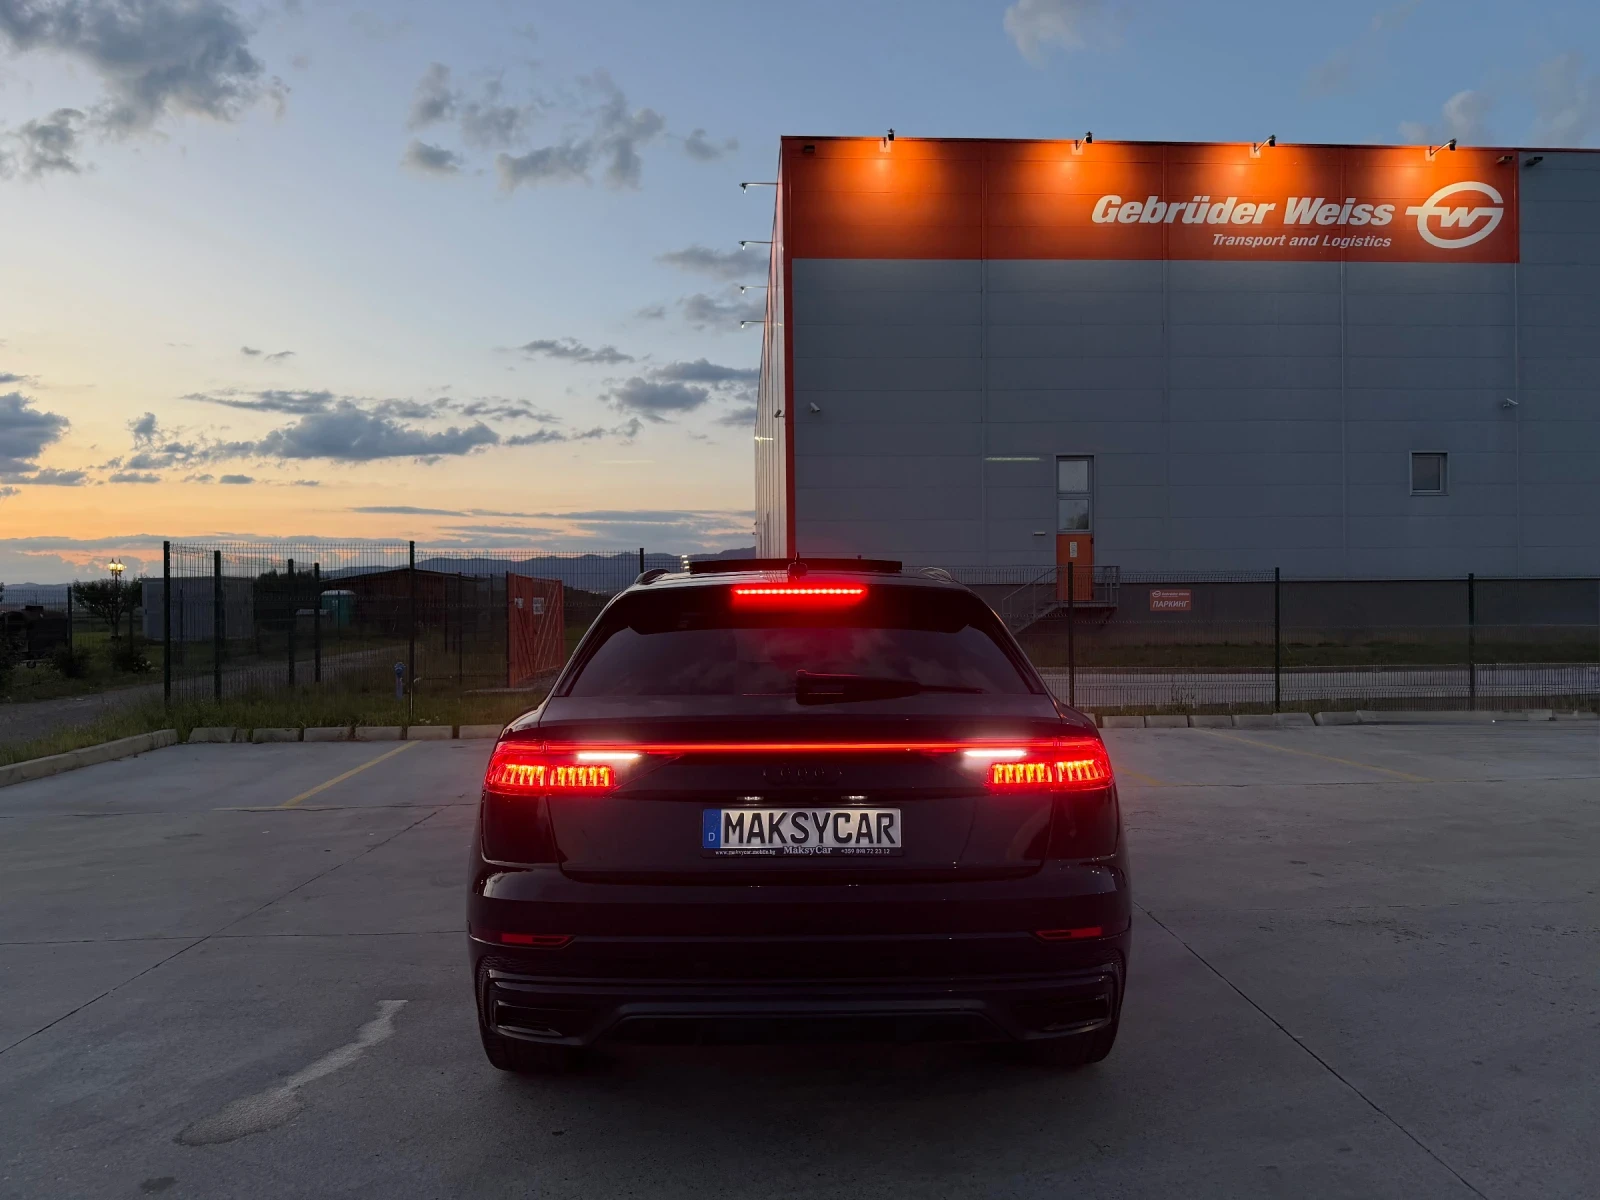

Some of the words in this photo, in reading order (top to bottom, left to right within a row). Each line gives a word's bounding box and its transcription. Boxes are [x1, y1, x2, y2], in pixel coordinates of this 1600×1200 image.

[1092, 195, 1276, 225] Gebrüder
[1283, 197, 1395, 226] Weiss
[1212, 233, 1286, 248] Transport
[1289, 234, 1318, 247] and
[1322, 235, 1392, 249] Logistics
[1152, 600, 1189, 608] ПАРКИНГ
[724, 812, 896, 844] MAKSYCAR
[708, 832, 716, 842] D
[783, 845, 833, 855] MaksyCar
